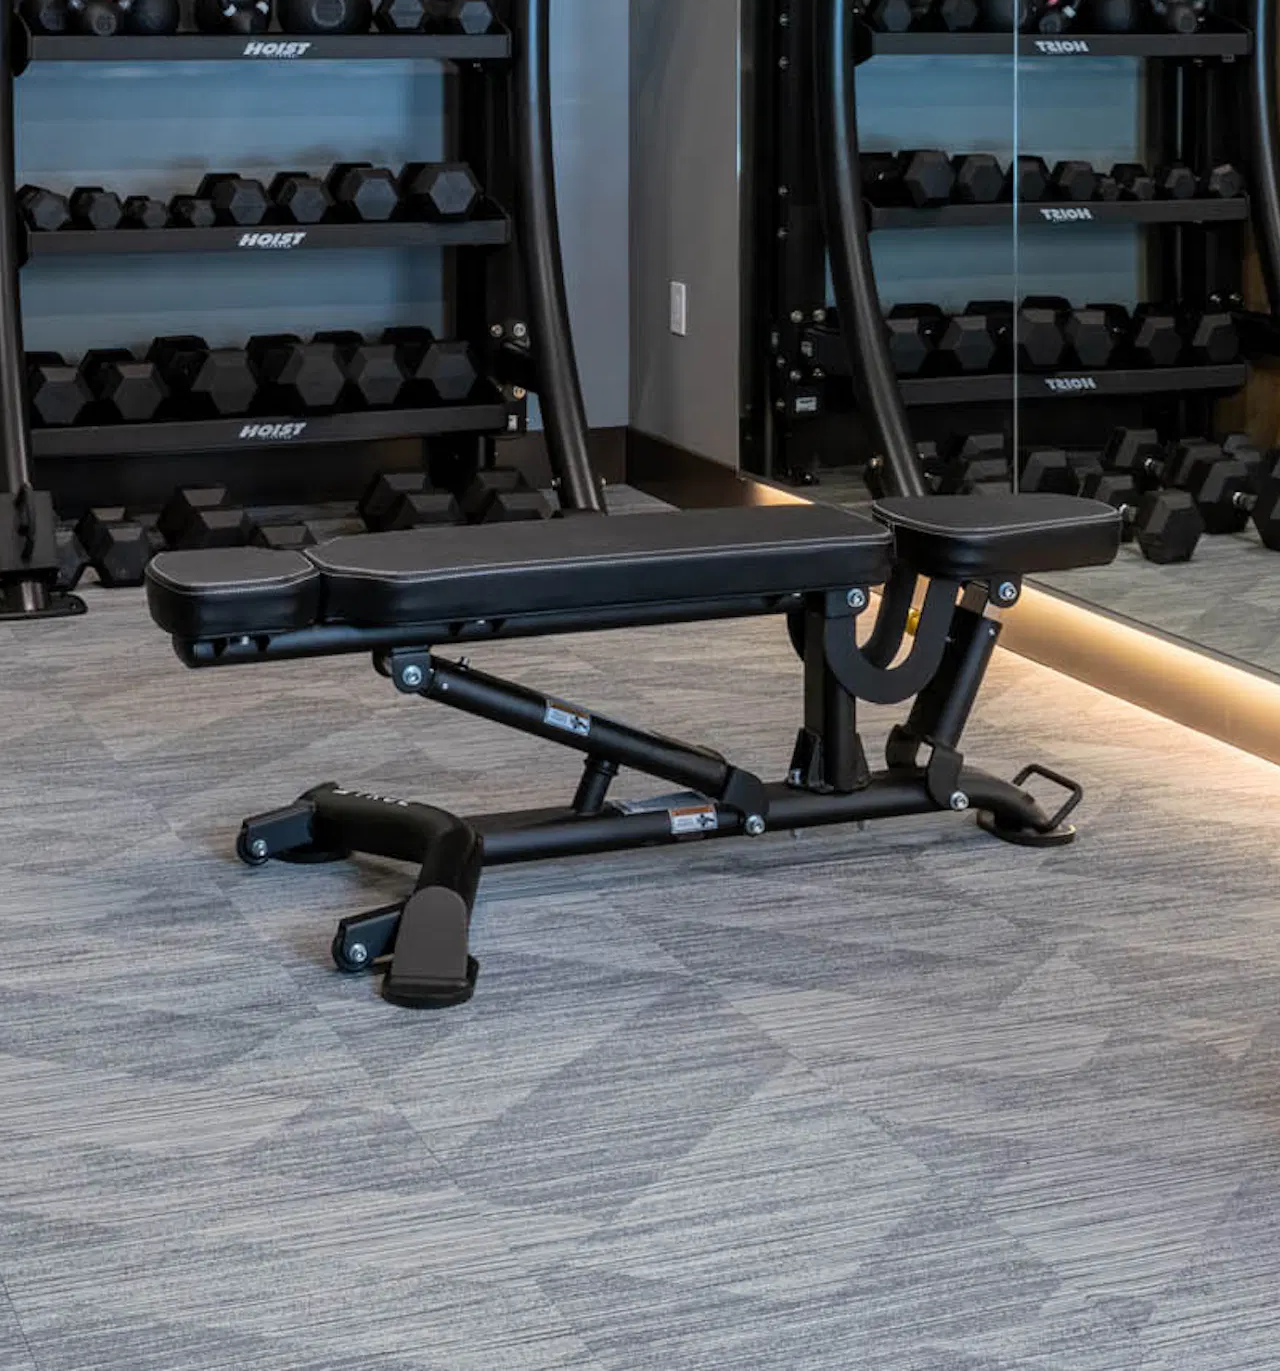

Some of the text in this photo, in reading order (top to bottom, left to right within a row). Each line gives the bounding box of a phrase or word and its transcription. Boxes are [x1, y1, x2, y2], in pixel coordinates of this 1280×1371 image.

[243, 41, 312, 56] HOIST
[239, 231, 307, 247] HOIST
[239, 422, 308, 439] HOIST
